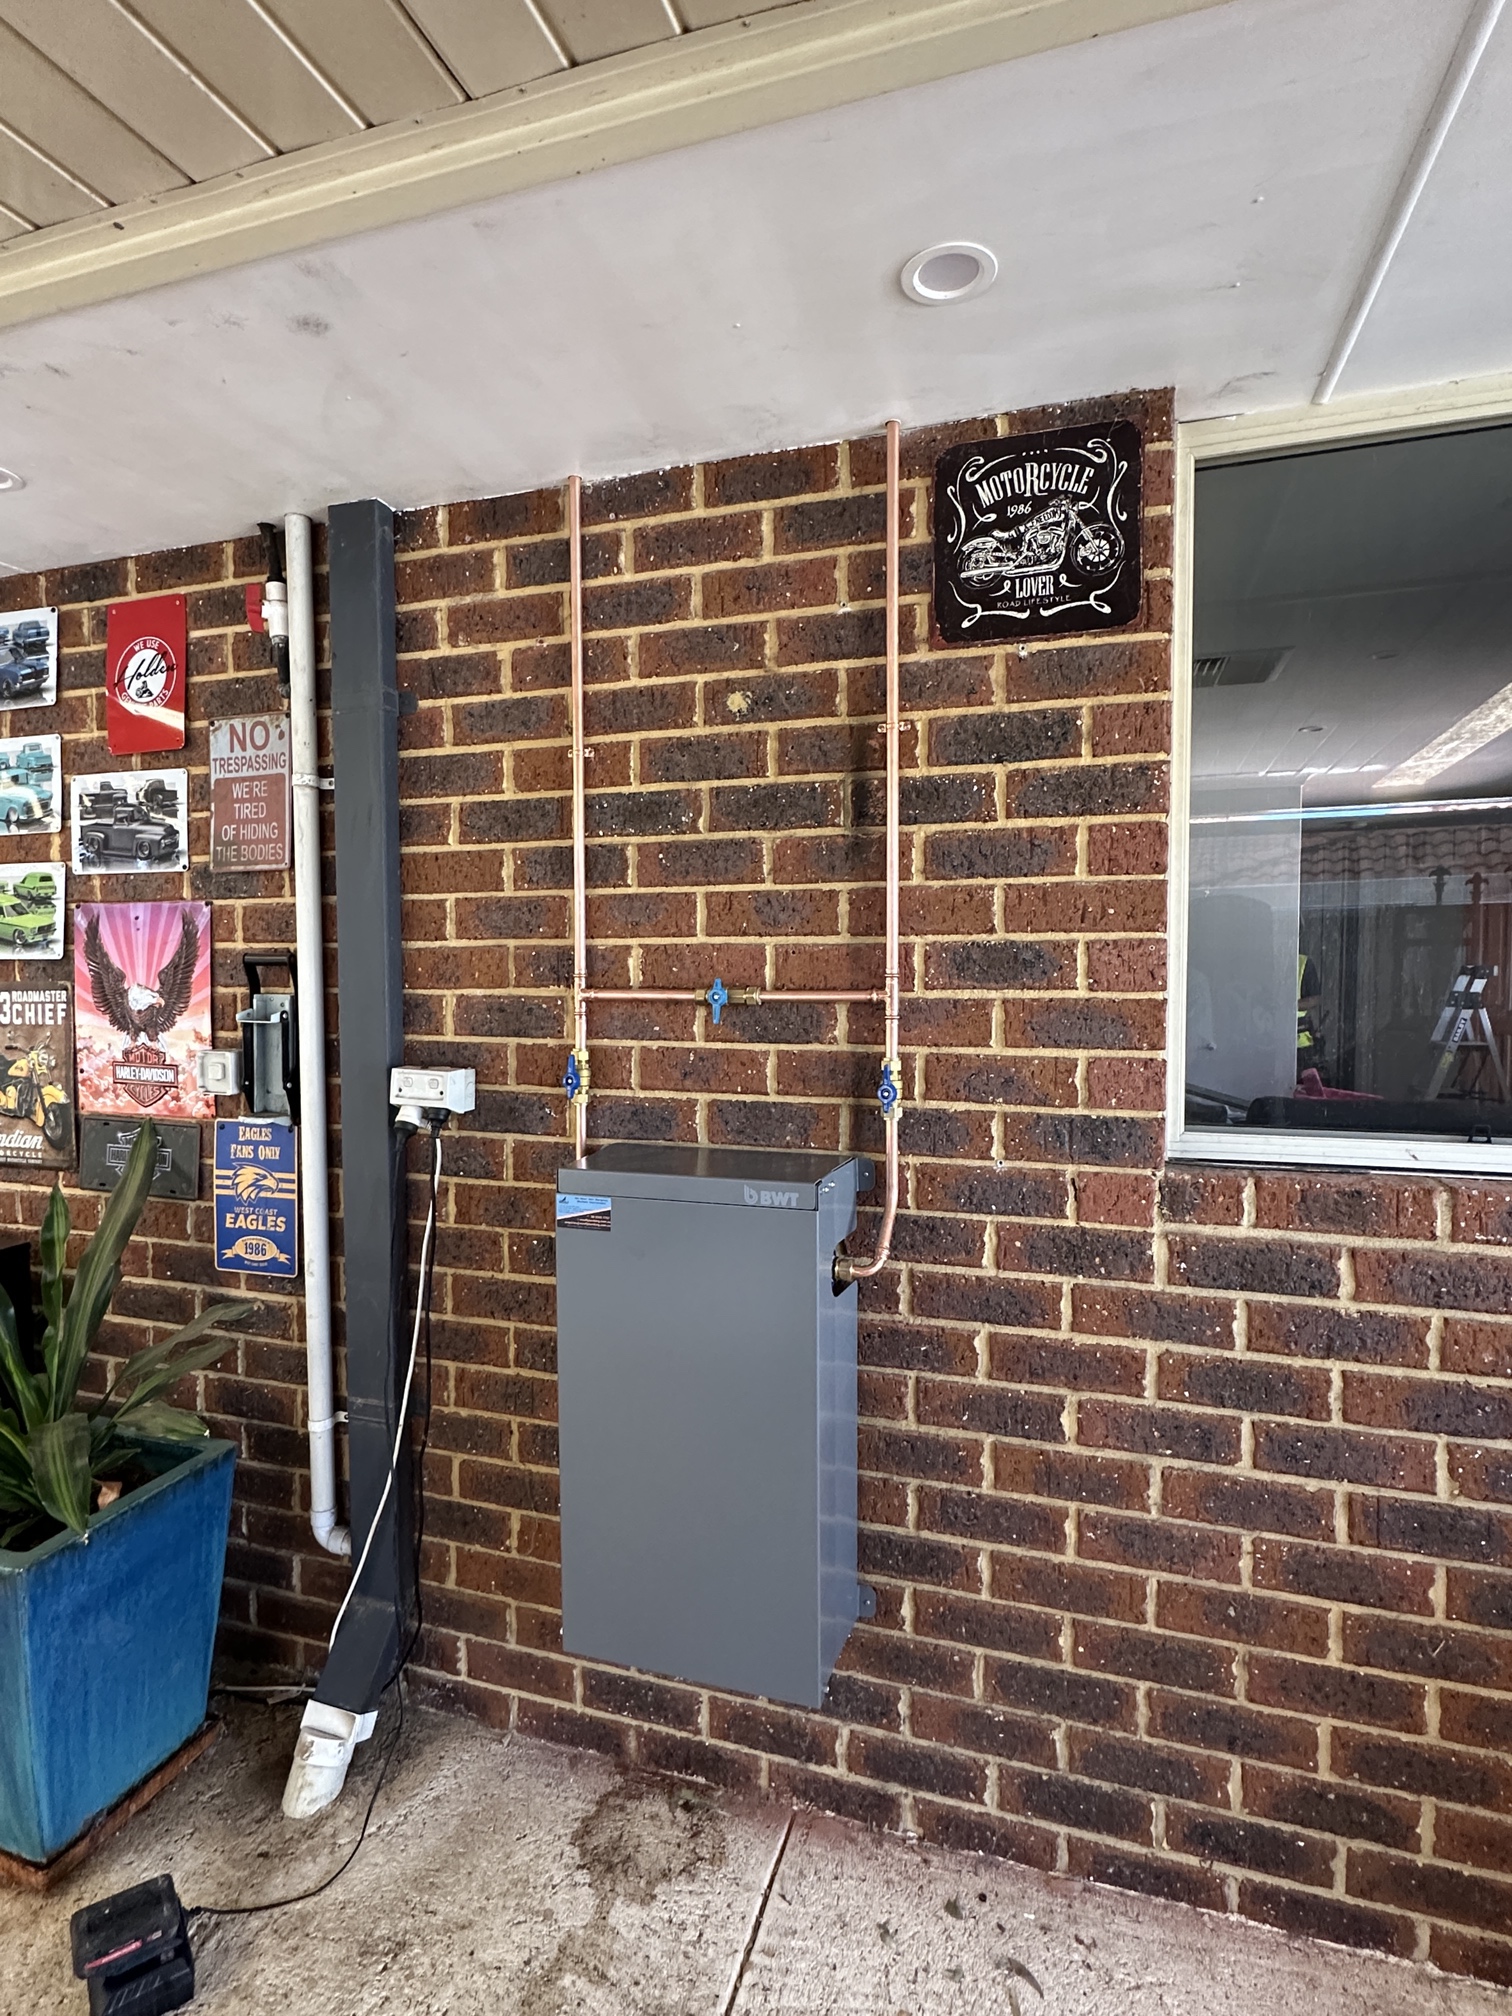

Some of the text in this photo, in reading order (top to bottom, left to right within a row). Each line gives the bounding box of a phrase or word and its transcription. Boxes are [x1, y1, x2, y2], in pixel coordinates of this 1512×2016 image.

[975, 462, 1095, 508] MOTORCYCLE
[1007, 501, 1032, 518] 1986
[1015, 575, 1054, 598] LOVER
[997, 595, 1072, 609] ROAD LIFESTYLE
[133, 640, 160, 652] WE USE
[113, 651, 178, 690] Holden
[229, 720, 270, 753] NO
[212, 752, 287, 775] TRESPASSING
[232, 781, 268, 799] WE'RE
[234, 802, 267, 820] TIRED
[221, 822, 278, 842] OF HIDING
[216, 843, 283, 862] THE BODIES
[11, 990, 67, 1003] ROADMASTER
[12, 1003, 67, 1025] CHIEF
[128, 1050, 159, 1065] MOTOR
[115, 1065, 175, 1082] HARLEY-DAVIDSON
[238, 1126, 272, 1141] EAGLES
[230, 1144, 280, 1160] FANS ONLY
[760, 1190, 799, 1207] BWT
[234, 1206, 278, 1216] WEST COAST
[225, 1213, 287, 1232] EAGLES
[244, 1242, 267, 1256] 1986
